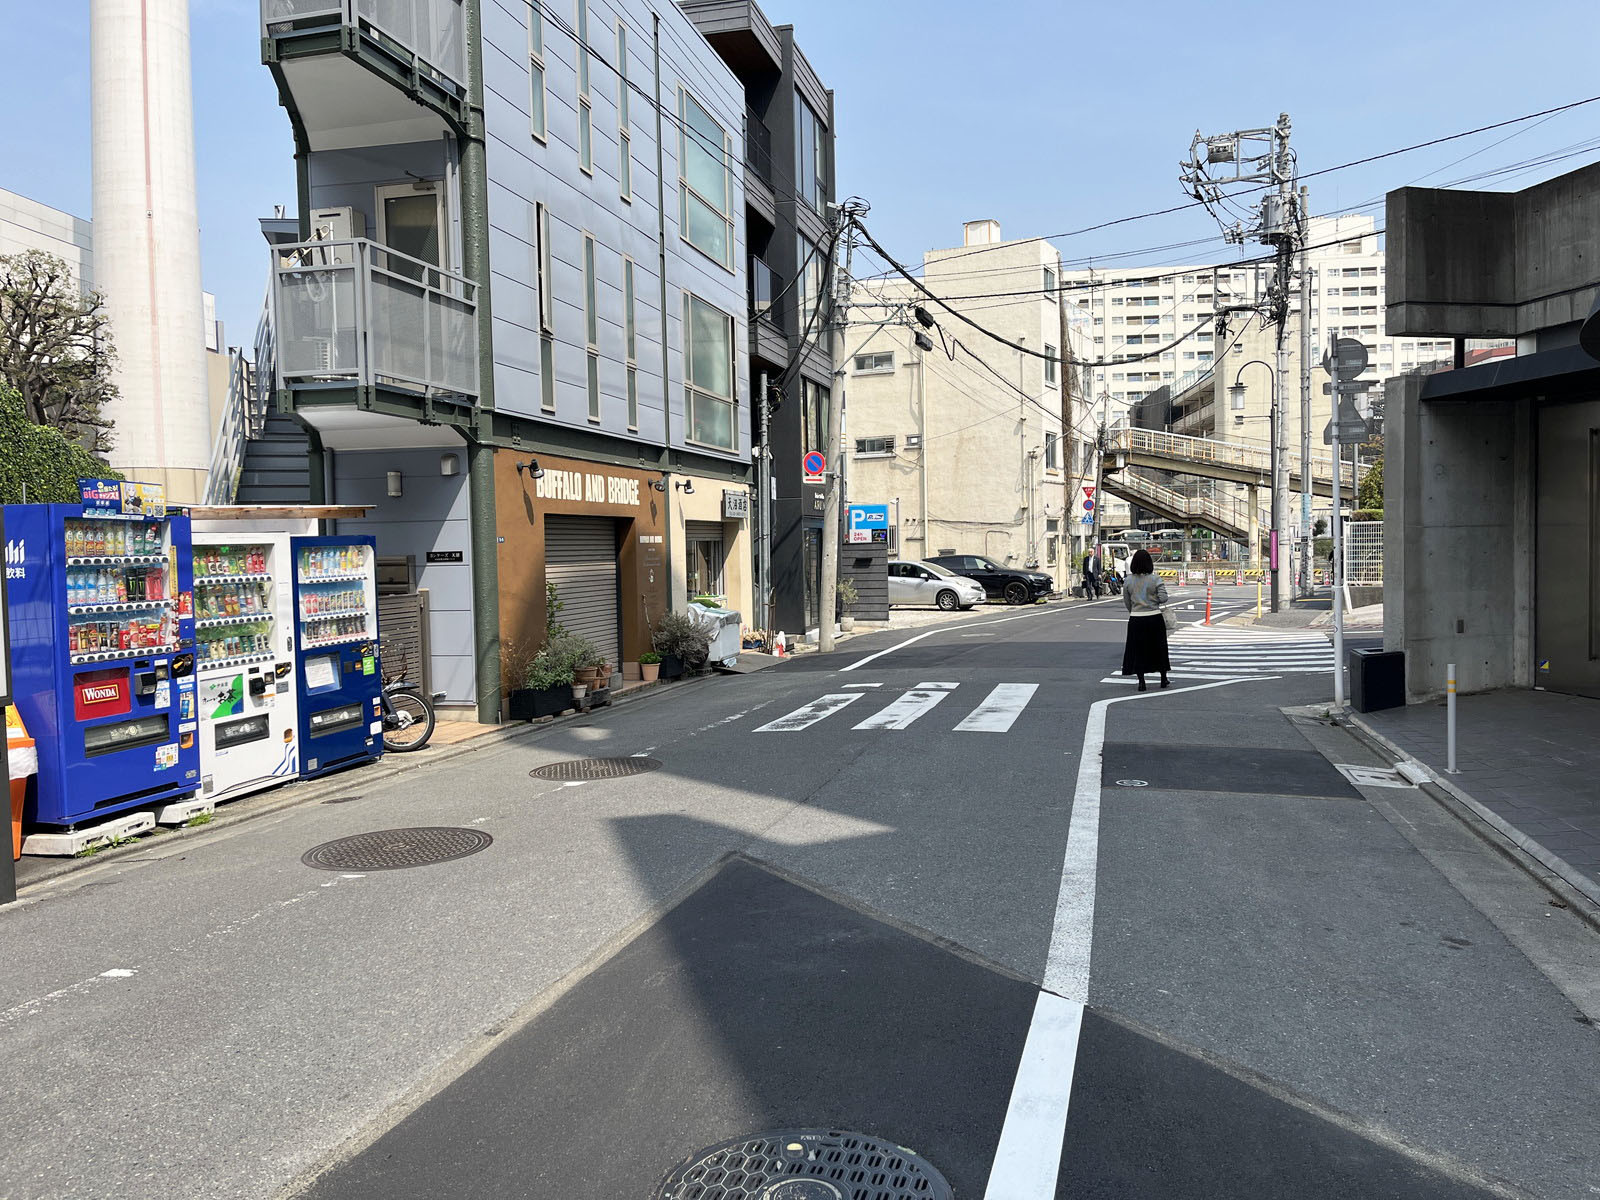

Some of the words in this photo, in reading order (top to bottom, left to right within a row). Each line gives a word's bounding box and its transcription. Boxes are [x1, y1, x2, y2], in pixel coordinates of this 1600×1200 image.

[536, 469, 582, 501] BUFFALO
[585, 473, 605, 503] AND
[607, 476, 640, 505] BRIDGE
[851, 509, 866, 530] P
[84, 687, 117, 701] WONDA
